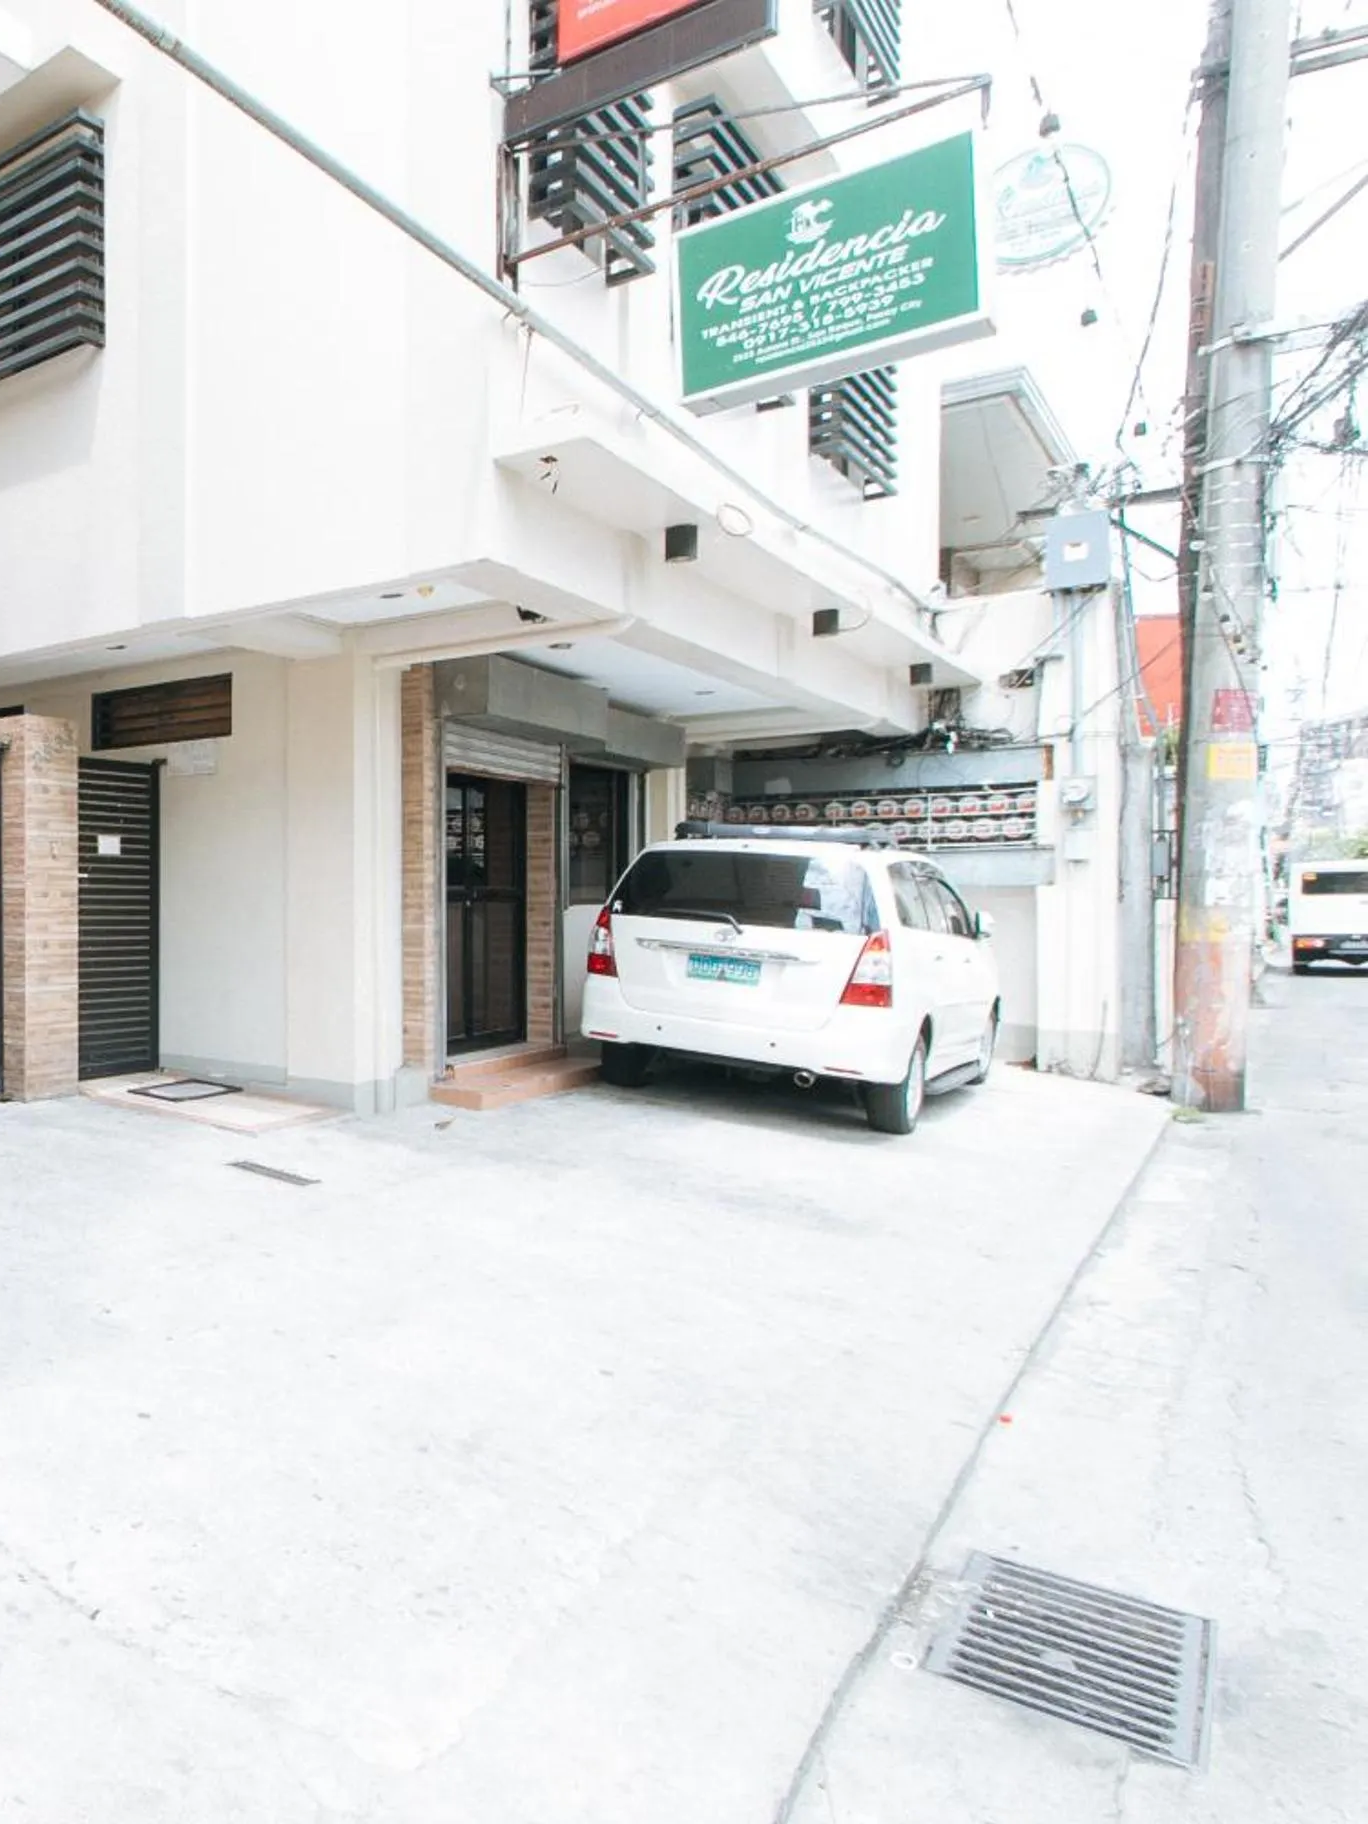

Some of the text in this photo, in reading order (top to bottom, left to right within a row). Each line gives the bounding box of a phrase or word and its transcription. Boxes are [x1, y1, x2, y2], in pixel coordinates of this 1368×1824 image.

[697, 210, 946, 308] Residencia
[736, 244, 909, 312] SAN VICENTE
[702, 256, 932, 340] TRANSIENT & BACKPACKER
[811, 305, 819, 320] /
